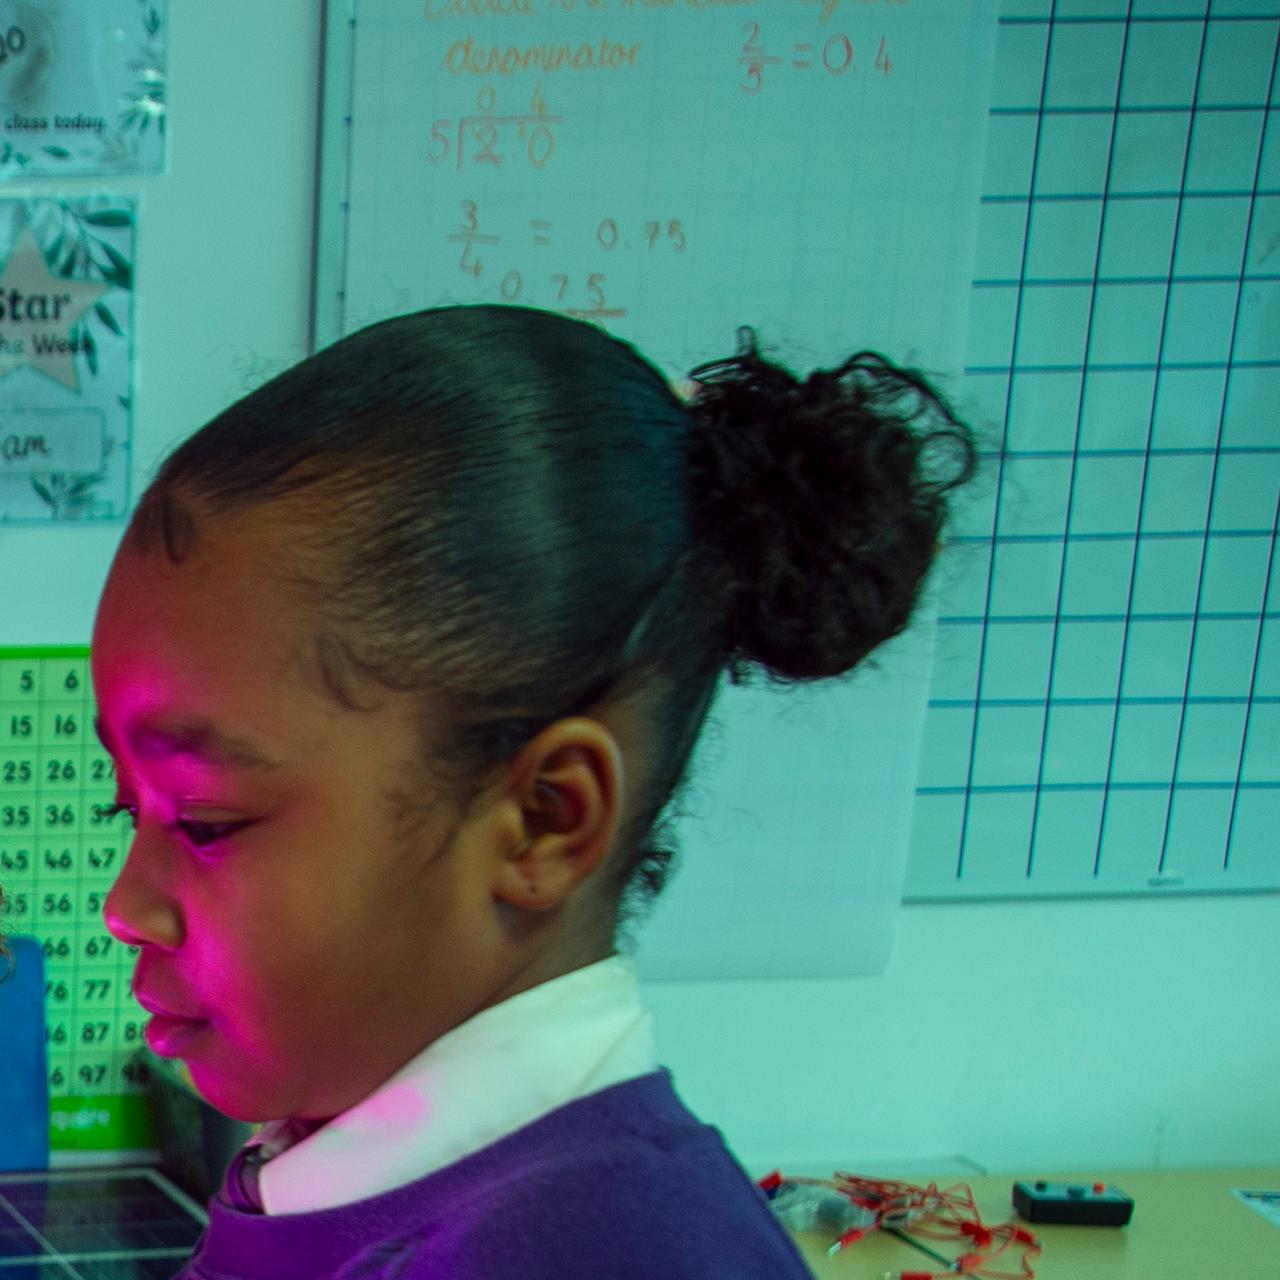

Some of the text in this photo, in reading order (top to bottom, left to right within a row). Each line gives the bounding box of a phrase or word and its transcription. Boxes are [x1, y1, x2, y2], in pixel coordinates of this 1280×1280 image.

[4, 113, 48, 130] class
[20, 670, 34, 693] 5
[65, 669, 80, 692] 6
[10, 715, 33, 737] 15
[55, 714, 78, 737] 16
[3, 761, 32, 783] 25
[47, 760, 77, 782] 26
[2, 805, 30, 827] 35
[45, 804, 75, 826] 36
[1, 848, 116, 870] 45 46 47
[44, 893, 72, 914] 56
[86, 936, 113, 957] 67
[84, 979, 112, 999] 77
[82, 1021, 110, 1044] 87
[79, 1064, 108, 1084] 97
[51, 1107, 111, 1132] quare
